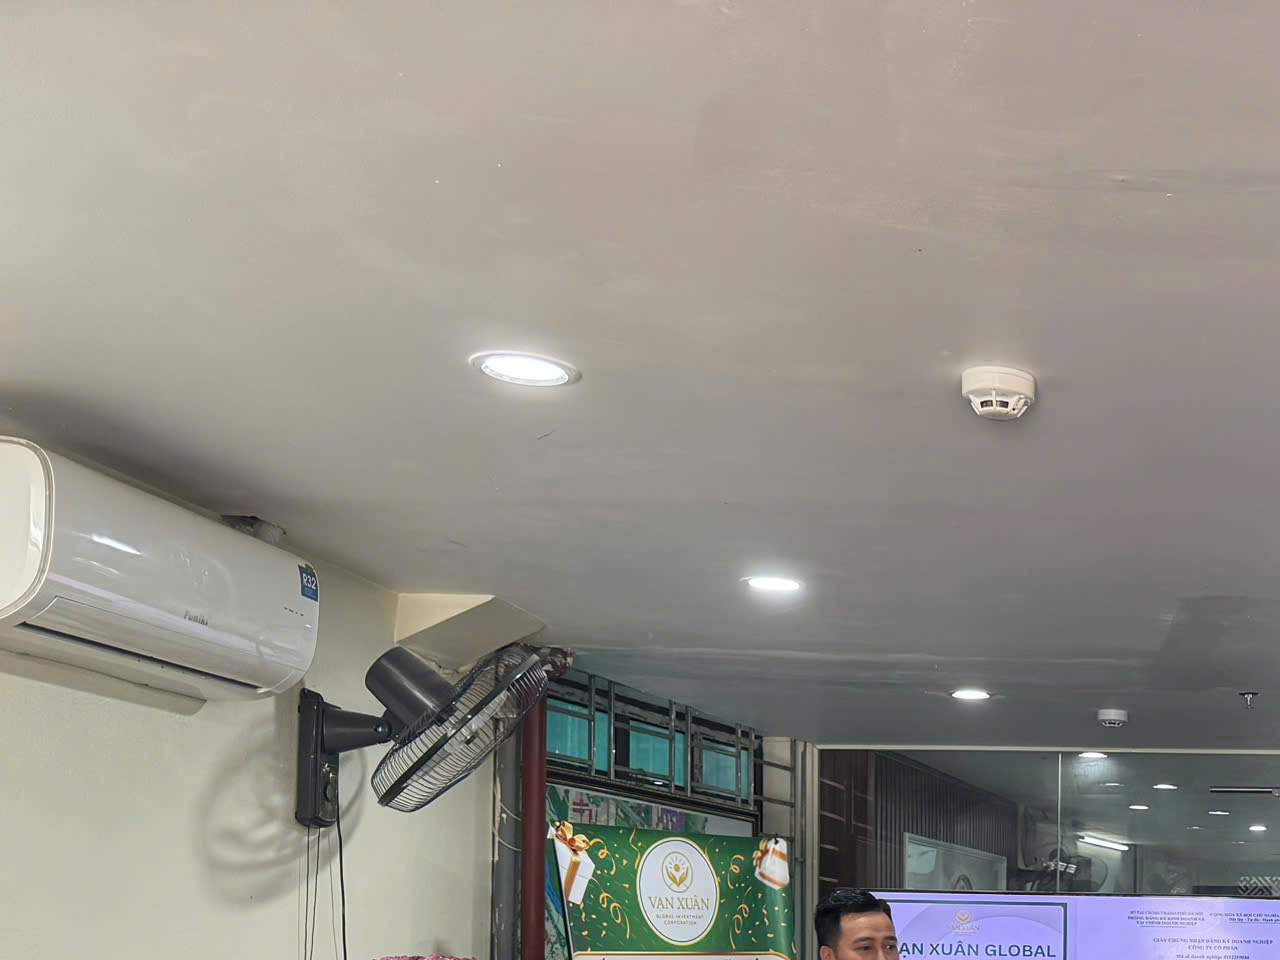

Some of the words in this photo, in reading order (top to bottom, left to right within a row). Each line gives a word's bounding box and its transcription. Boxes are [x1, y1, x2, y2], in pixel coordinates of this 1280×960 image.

[302, 572, 316, 590] R32
[677, 894, 710, 910] XUÂN
[900, 942, 924, 958] ẠN
[929, 940, 979, 956] XUÂN
[985, 944, 1057, 958] GLOBAL
